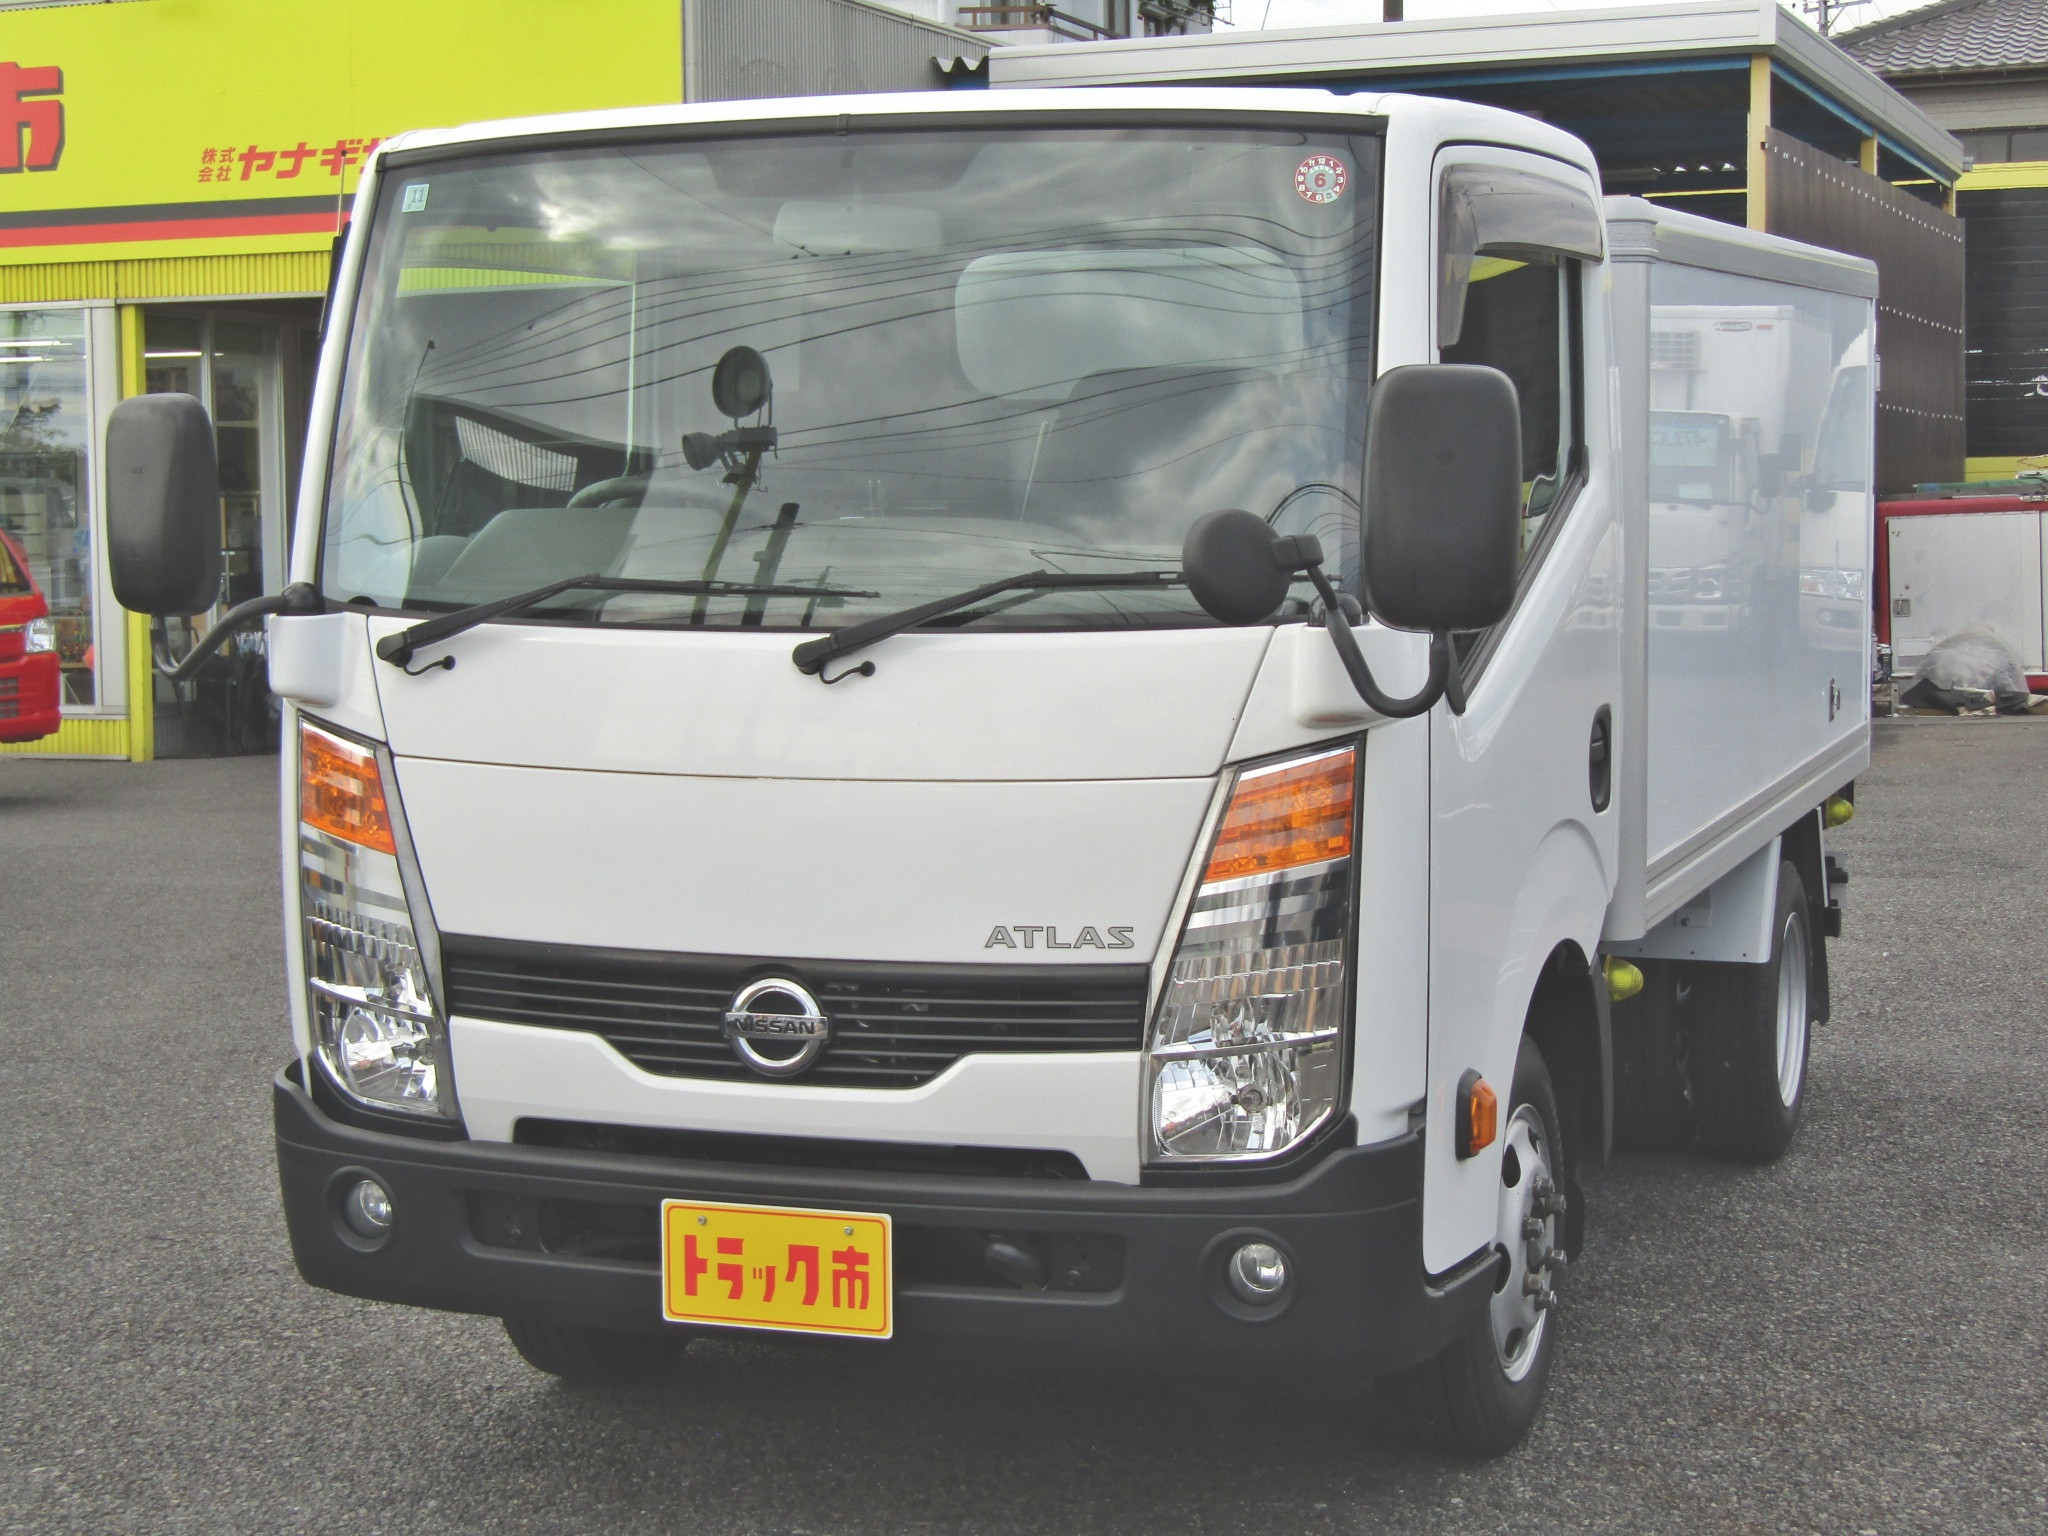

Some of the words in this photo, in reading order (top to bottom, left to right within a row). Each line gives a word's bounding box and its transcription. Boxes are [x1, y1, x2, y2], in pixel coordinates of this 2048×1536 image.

[202, 147, 236, 164] 株式
[198, 165, 232, 182] 会社
[1314, 172, 1327, 188] 6
[985, 925, 1135, 949] ATLAS
[733, 1016, 815, 1035] NISSAN
[684, 1234, 870, 1310] トラック市
